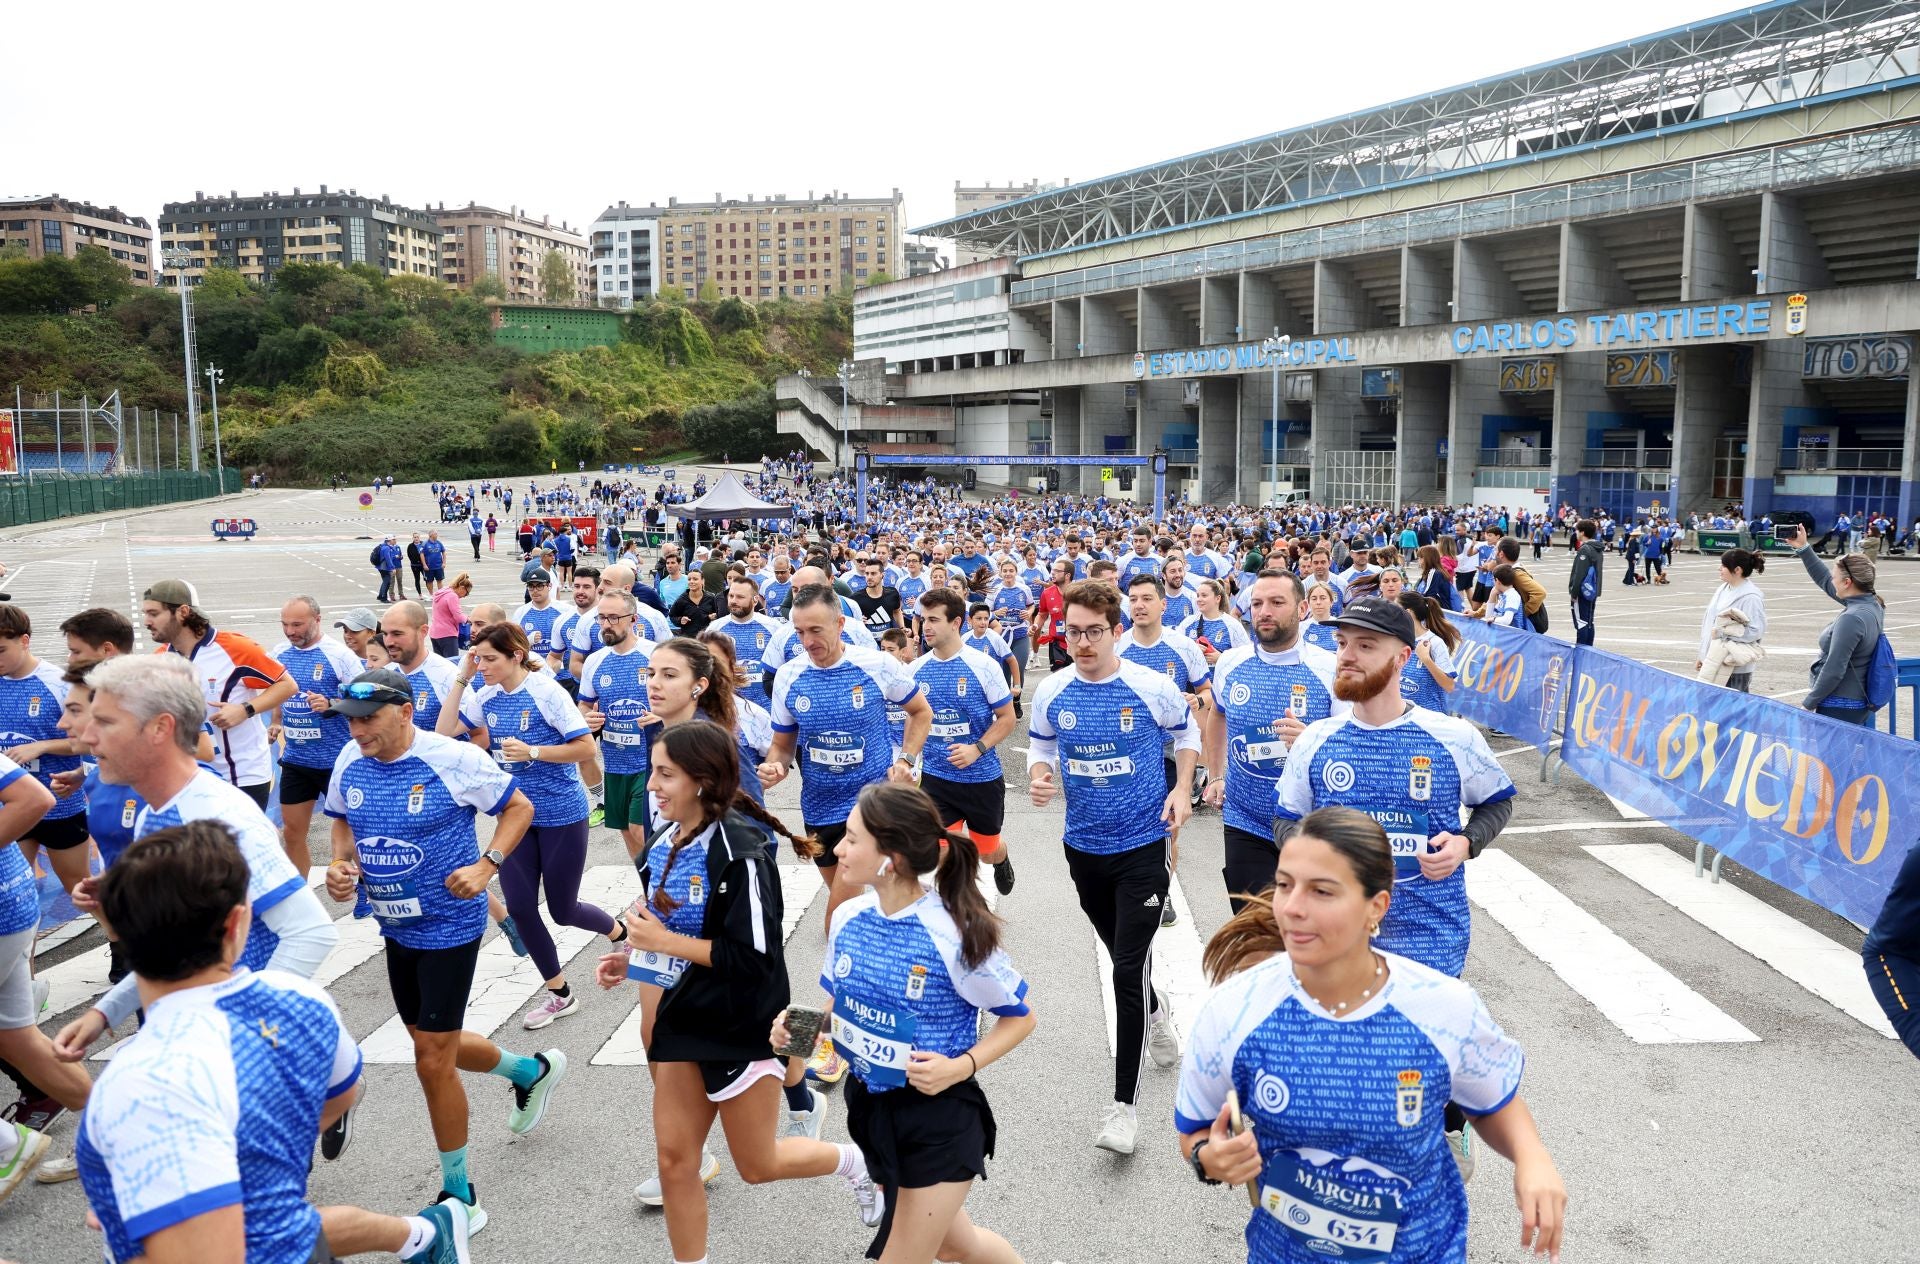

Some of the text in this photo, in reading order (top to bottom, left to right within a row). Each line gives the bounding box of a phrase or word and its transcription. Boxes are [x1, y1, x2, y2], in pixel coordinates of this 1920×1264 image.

[1452, 318, 1576, 353] CARLOS
[1590, 301, 1771, 343] TARTIERE
[1150, 348, 1231, 376] ESTADIO
[1236, 337, 1358, 369] MUNICIPAL
[1102, 470, 1111, 479] P2
[1715, 541, 1736, 549] Unicaja
[817, 735, 853, 745] MARCHA
[1074, 743, 1116, 753] MARCHA
[1571, 673, 1889, 865] REAL OVIEDO
[1364, 811, 1413, 824] ARCHA
[1389, 838, 1417, 852] 99
[360, 848, 417, 866] ASTURIANA
[387, 903, 412, 916] 106
[844, 996, 896, 1027] MARCHA
[1295, 1168, 1382, 1209] MARCHA
[1327, 1219, 1378, 1245] 634
